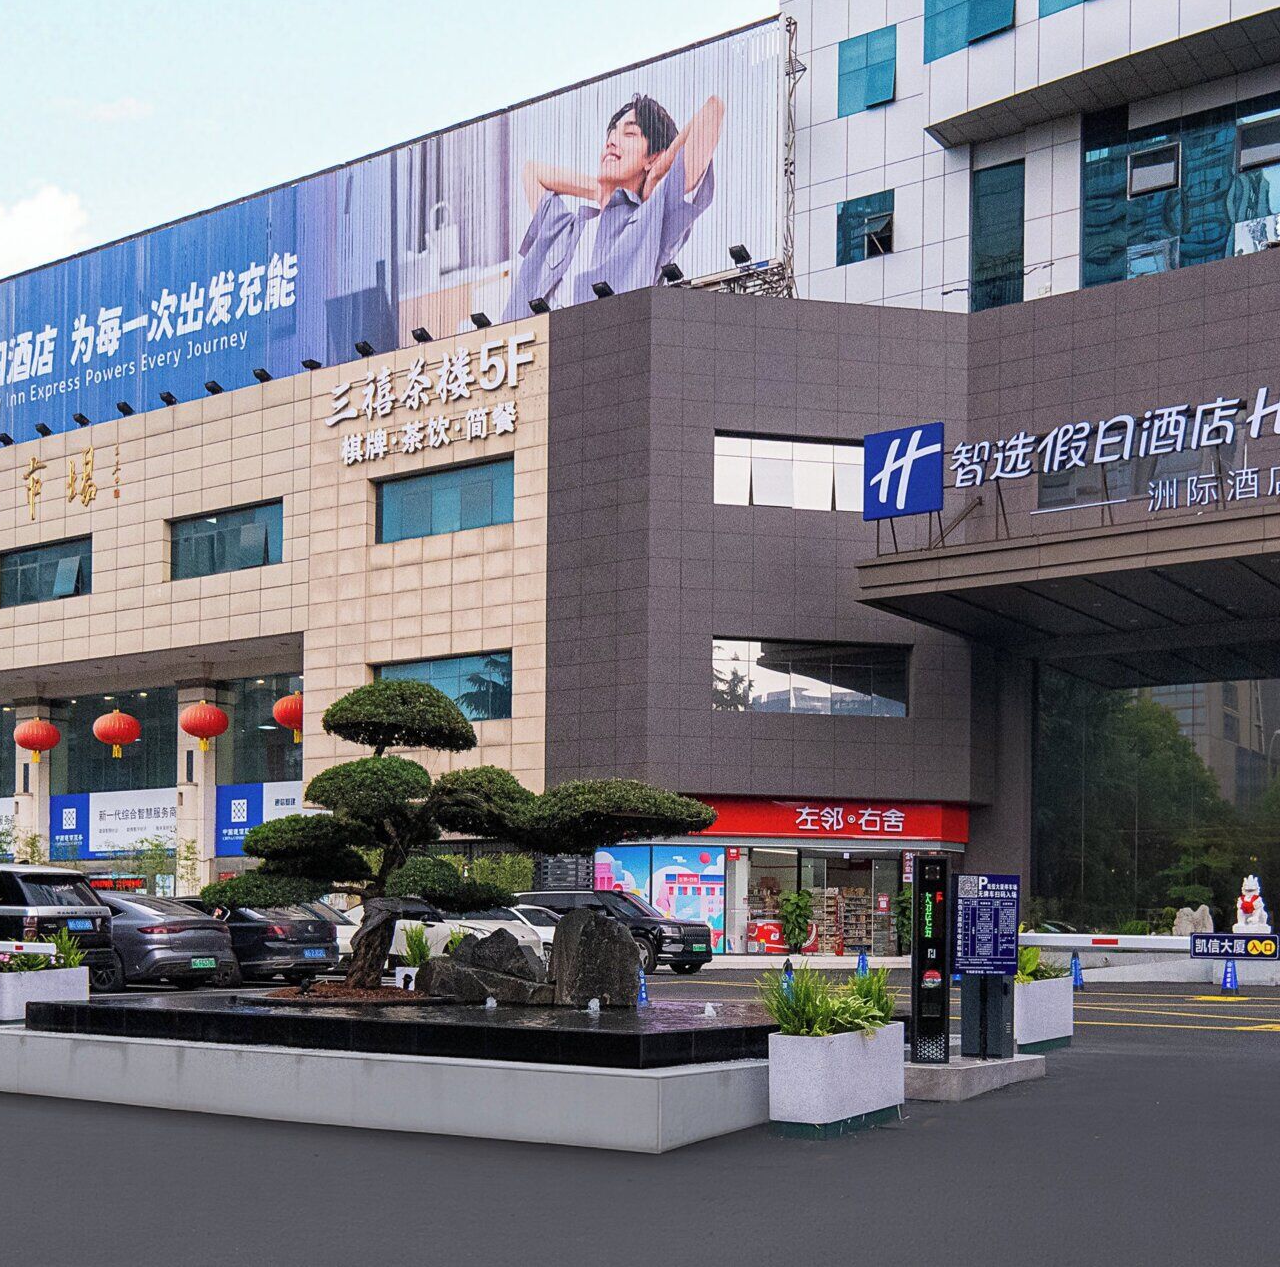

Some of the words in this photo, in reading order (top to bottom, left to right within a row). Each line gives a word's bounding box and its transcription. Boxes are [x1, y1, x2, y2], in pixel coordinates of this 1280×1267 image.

[70, 252, 299, 367] 为每一次出发充能
[6, 390, 26, 408] Inn
[30, 379, 81, 404] Express
[86, 361, 136, 386] Powers
[141, 345, 181, 372] Every
[187, 330, 248, 360] Journey
[949, 397, 1240, 489] 智选假日酒店
[978, 876, 989, 890] P
